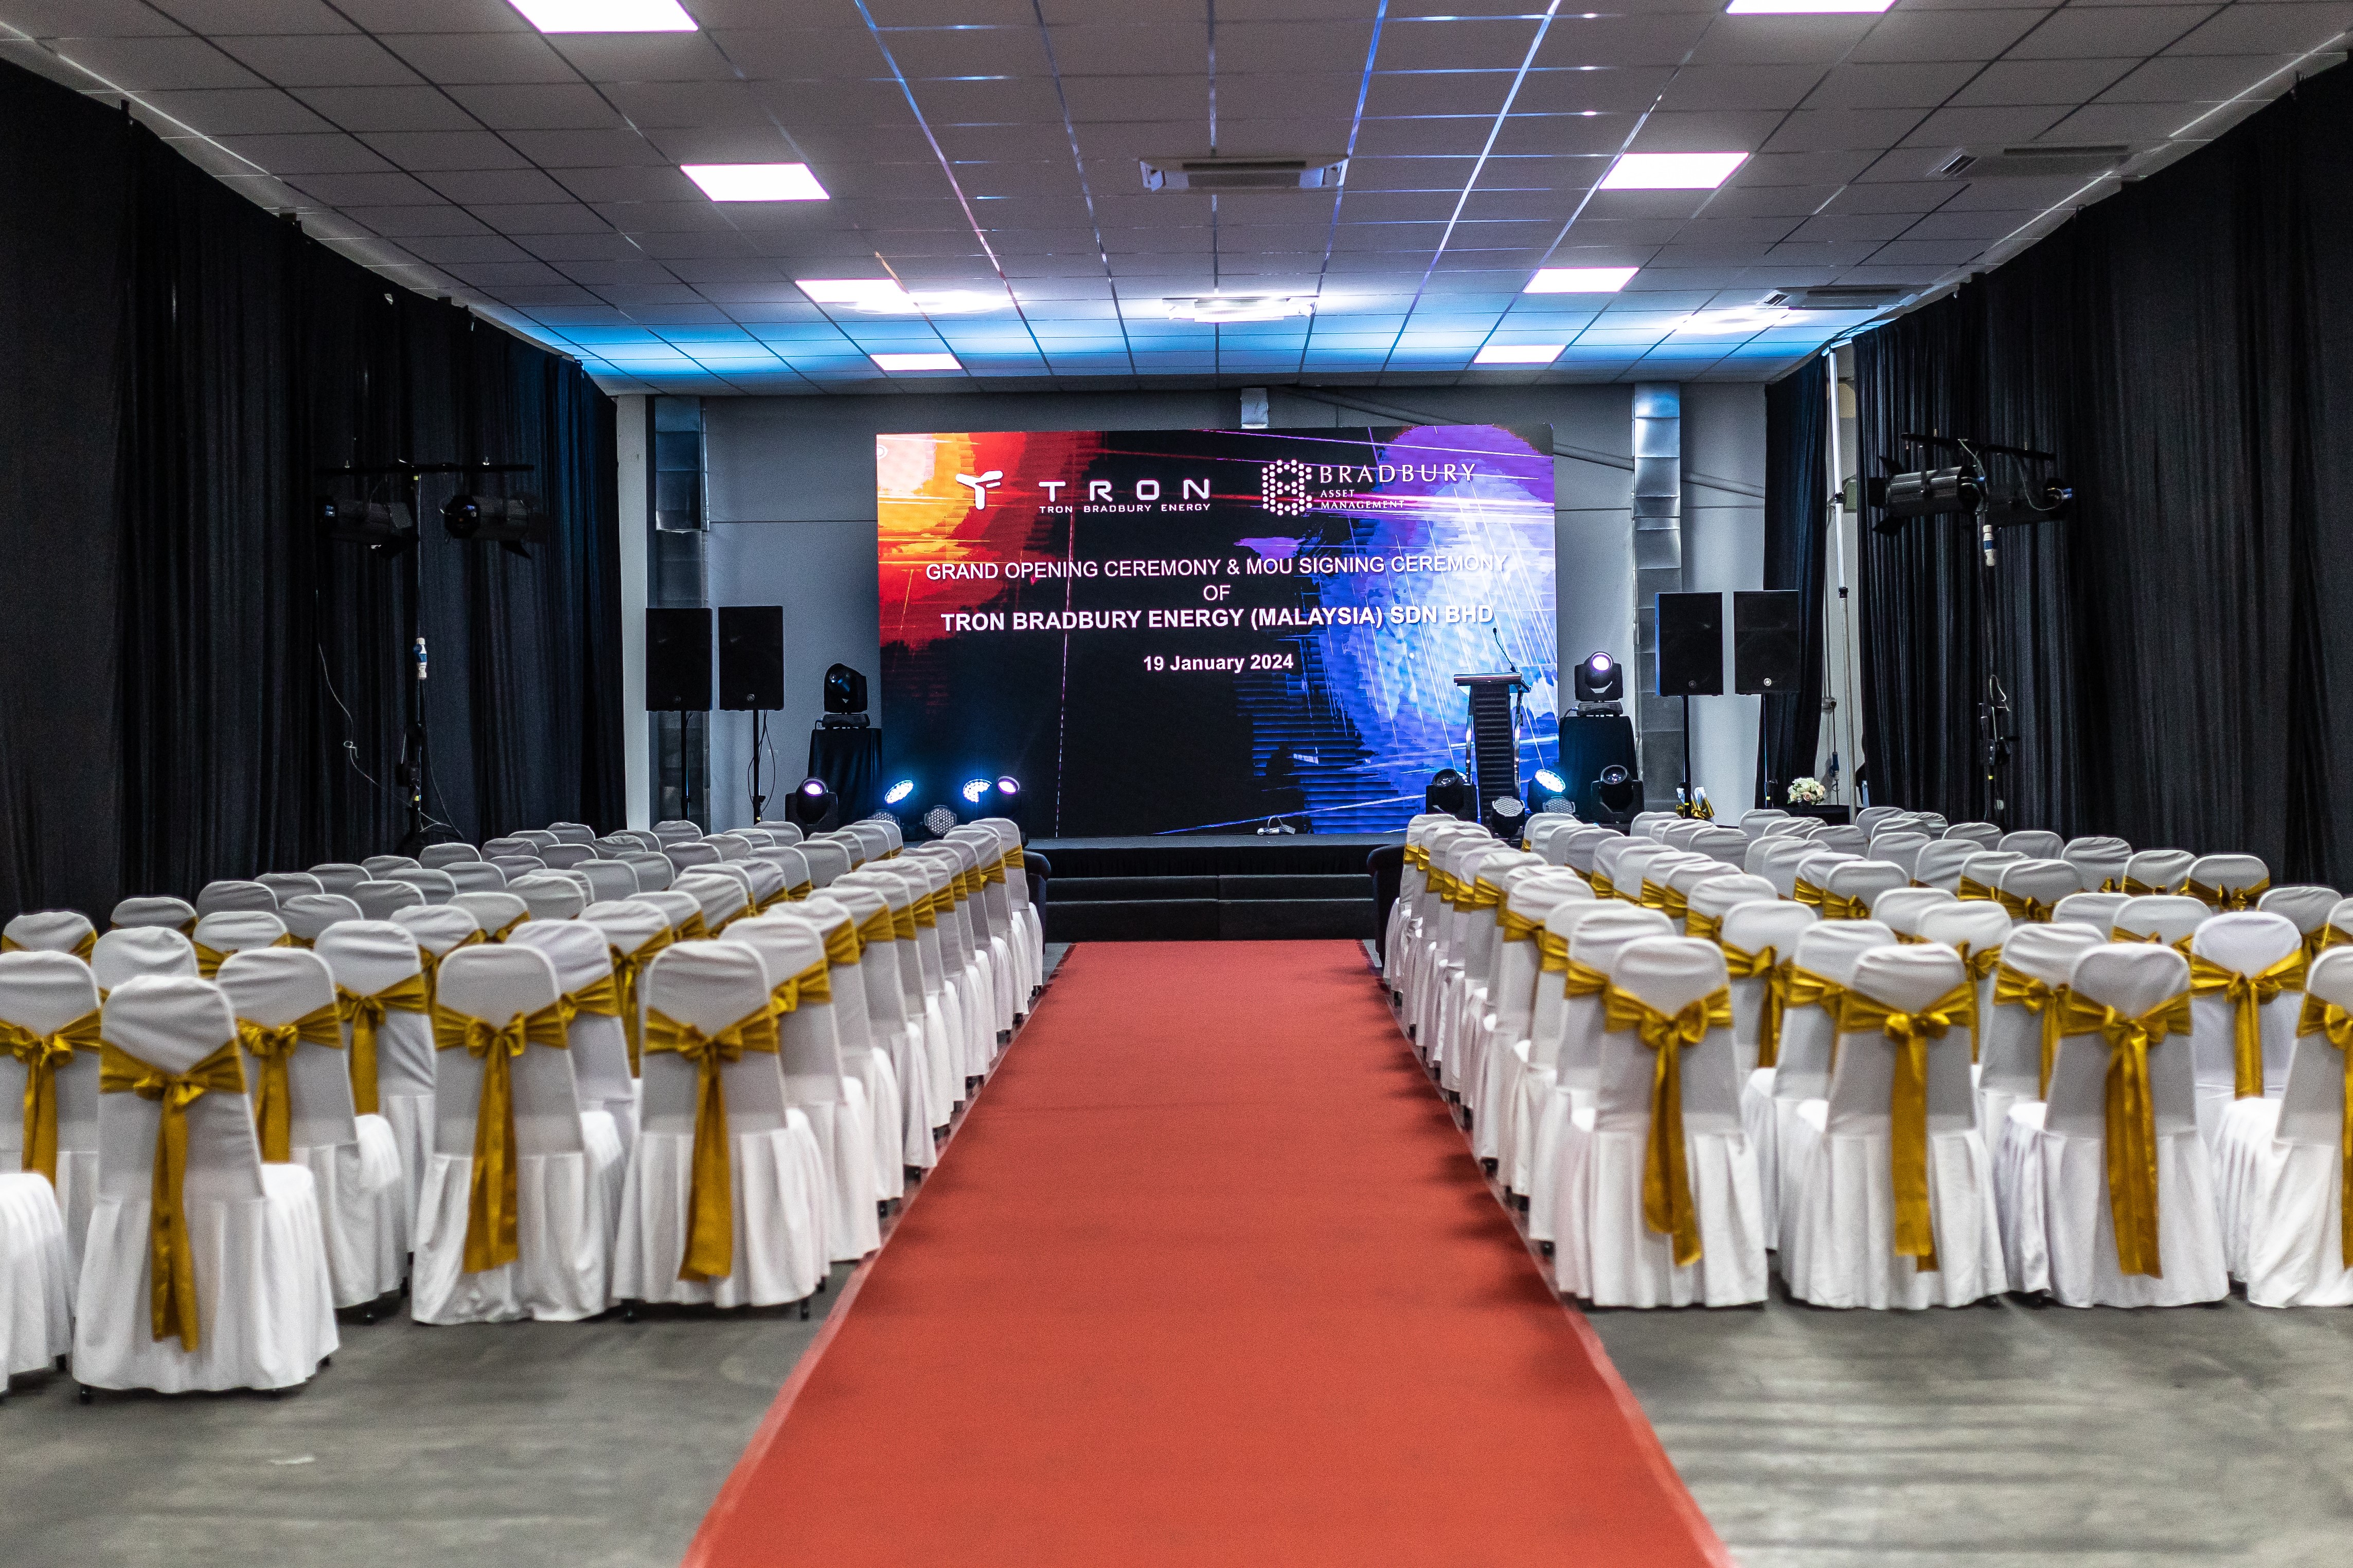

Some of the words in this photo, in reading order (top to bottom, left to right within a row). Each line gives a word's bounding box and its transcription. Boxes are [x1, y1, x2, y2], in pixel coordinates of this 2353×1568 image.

[1320, 463, 1476, 483] BRADBURY
[1038, 479, 1211, 502] TRON
[1321, 489, 1355, 498] ASSET
[1039, 506, 1073, 514] TRON
[1083, 504, 1152, 513] BRADBURY
[1161, 503, 1211, 512] ENERGY
[1321, 500, 1405, 510] MANAGEMENT
[926, 563, 999, 580] GRAND
[1005, 561, 1098, 579] OPENING
[1104, 559, 1221, 577] CEREMONY
[1227, 558, 1240, 575] &
[1247, 558, 1292, 574] MOU
[1299, 556, 1384, 573] SIGNING
[1391, 554, 1508, 572] CEREMONY
[1203, 584, 1231, 601] OF
[941, 612, 1004, 632] TRON
[1012, 610, 1142, 630] BRADBURY
[1148, 608, 1244, 627] ENERGY
[1251, 606, 1383, 630] (MALAYSIA)
[1389, 605, 1437, 624] SDN
[1445, 604, 1493, 623] BHD
[1144, 656, 1164, 671] 19
[1170, 655, 1245, 674] January
[1250, 654, 1294, 670] 2024
